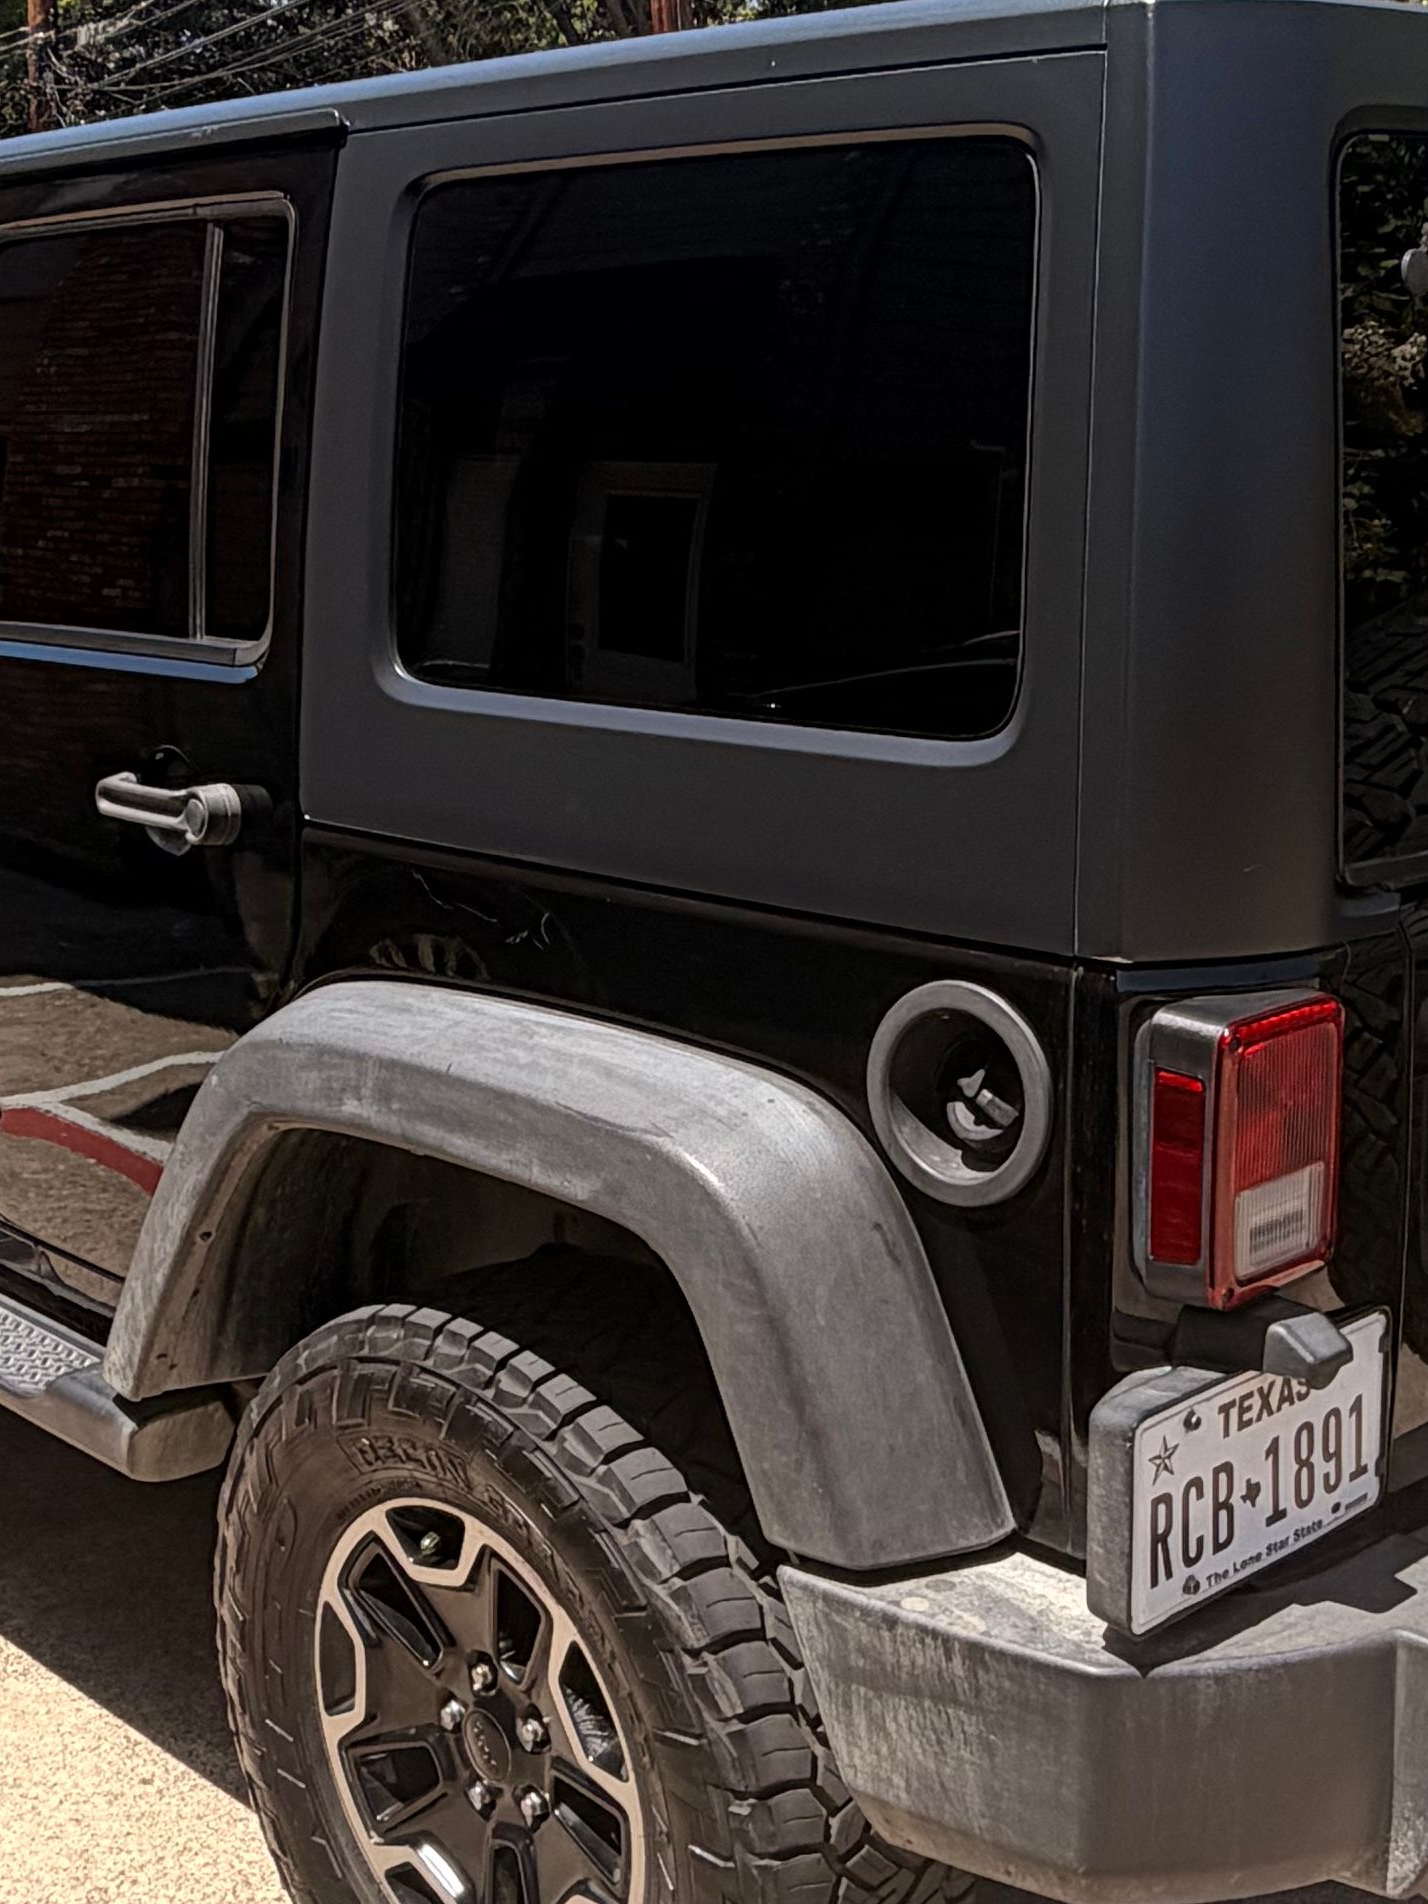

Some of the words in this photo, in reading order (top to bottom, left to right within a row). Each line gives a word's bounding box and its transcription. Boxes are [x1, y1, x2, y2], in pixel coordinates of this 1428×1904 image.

[1150, 1461, 1234, 1589] RCB
[1265, 1394, 1368, 1527] 1891
[1206, 1569, 1229, 1587] The
[1233, 1552, 1262, 1573] Lone
[1265, 1536, 1289, 1556] Star
[1293, 1519, 1323, 1542] State
